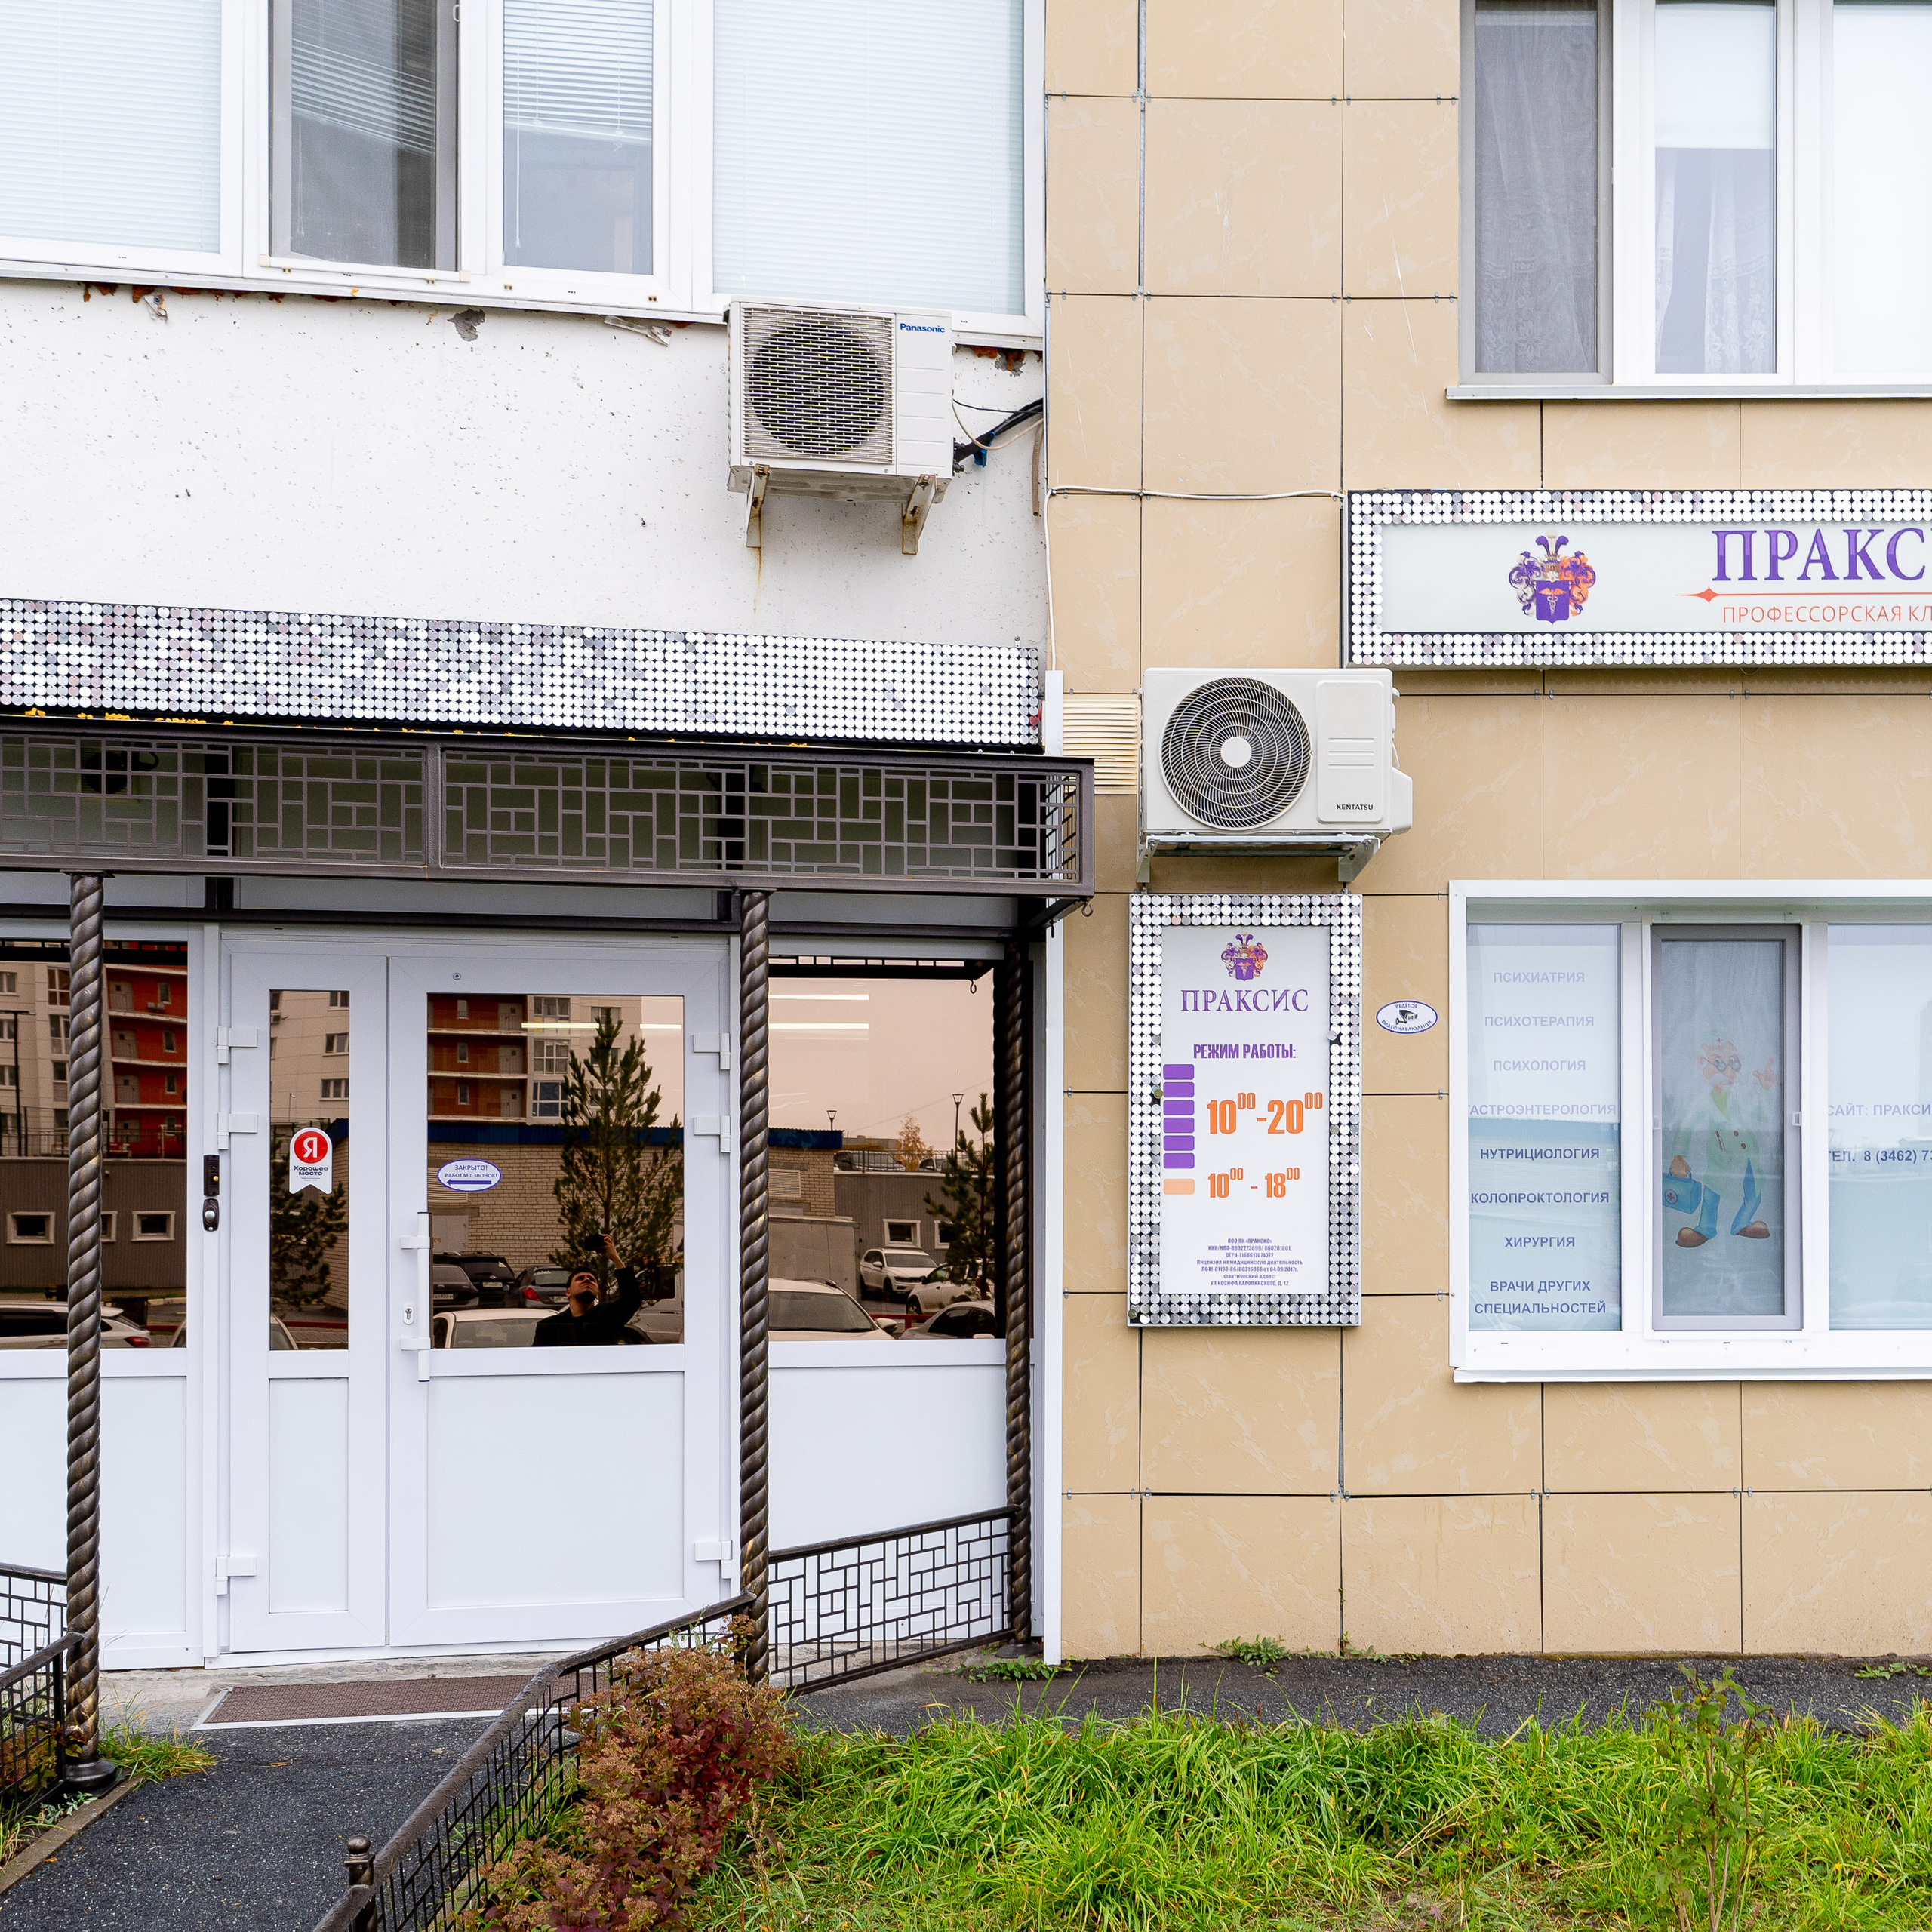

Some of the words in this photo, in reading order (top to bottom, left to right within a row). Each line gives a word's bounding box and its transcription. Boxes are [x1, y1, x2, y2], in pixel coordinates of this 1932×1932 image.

[900, 323, 945, 333] Panasonic
[1712, 528, 1932, 580] ПРАКС
[1723, 605, 1901, 623] ПРОФЕССОРСКАЯ
[1909, 605, 1932, 622] КЛ
[1493, 971, 1585, 983] ПСИХИАТРИЯ
[1180, 989, 1309, 1012] ПРАКСИС
[1484, 1016, 1594, 1026] ПСИХОТЕРАПИЯ
[1193, 1044, 1239, 1059] РЕЖИМ
[1243, 1044, 1297, 1059] РАБОТЫ:
[1493, 1060, 1586, 1071] ПСИХОЛОГИЯ
[1468, 1104, 1616, 1115] АСТРОЭНТЕРОЛОГИЯ
[1828, 1103, 1868, 1116] САЙТ:
[303, 1137, 318, 1158] Я
[1481, 1149, 1600, 1161] НУТРИЦИОЛОГИЯ
[1828, 1150, 1855, 1162] ЕЛ.
[1863, 1150, 1872, 1161] 8
[1875, 1149, 1917, 1164] (3462)
[1921, 1150, 1932, 1161] 7
[1471, 1192, 1609, 1203] КОЛОПРОКТОЛОГИЯ
[1505, 1237, 1575, 1247] ХИРУРГИЯ
[1490, 1281, 1534, 1292] ВРАЧИ
[1537, 1281, 1591, 1294] ДРУГИХ
[1475, 1300, 1606, 1315] СПЕЦИАЛЬНОСТЕЙ
